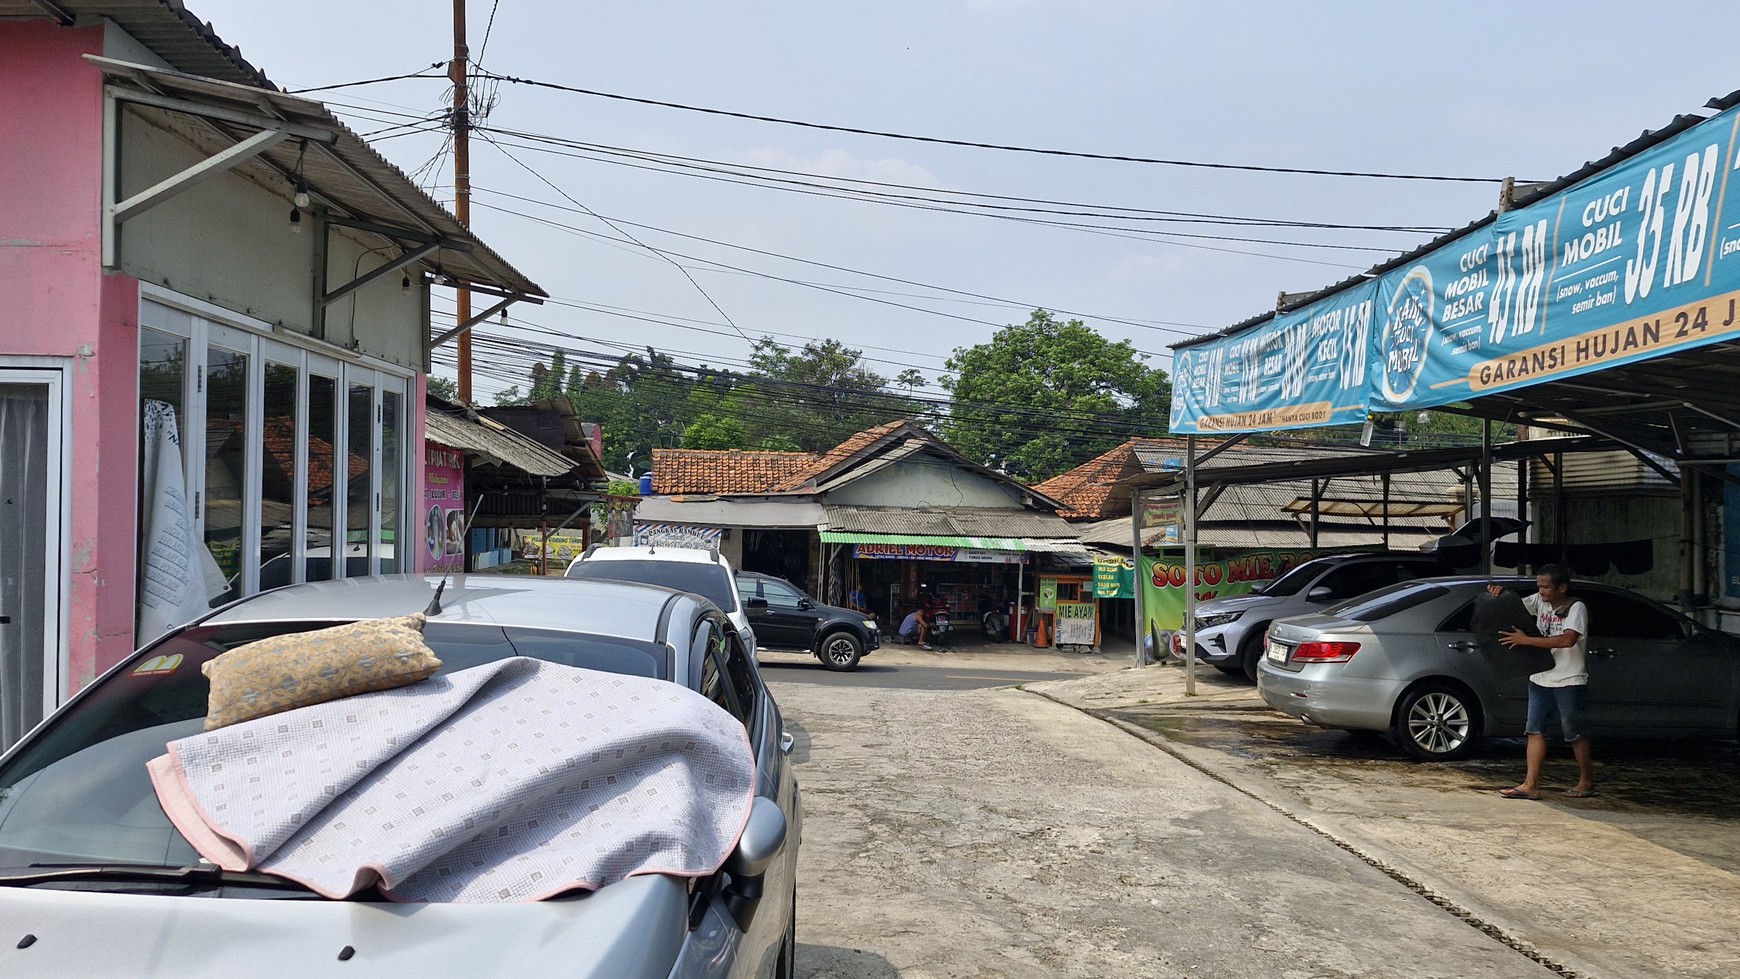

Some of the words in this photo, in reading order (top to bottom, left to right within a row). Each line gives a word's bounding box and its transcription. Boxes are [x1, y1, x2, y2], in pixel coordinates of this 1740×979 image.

[1582, 186, 1630, 227] CUCI
[1625, 163, 1674, 305] 35
[1664, 143, 1718, 288] RB
[1460, 243, 1489, 273] CUCI
[1562, 221, 1623, 267] MOBIL
[1444, 268, 1489, 300] MOBIL
[1488, 232, 1516, 344] 45
[1511, 219, 1547, 337] RB
[1557, 283, 1582, 302] (snow,
[1585, 270, 1619, 289] vaccum,
[1442, 291, 1484, 323] BESAR
[1572, 294, 1595, 314] semir
[1596, 285, 1616, 306] ban)
[1312, 310, 1341, 337] MOTOR
[1480, 345, 1565, 385] GARANSI
[1575, 319, 1660, 363] HUJAN
[1674, 307, 1708, 338] 24
[1200, 416, 1224, 428] GARANSI
[1226, 414, 1246, 427] HUJAN
[1248, 413, 1256, 426] 24
[1312, 410, 1326, 420] BODY
[856, 544, 903, 556] ADRIEL
[905, 544, 954, 557] MOTOR
[1227, 553, 1275, 584] MIE
[1059, 605, 1072, 618] MIE
[1074, 605, 1094, 619] AYAM
